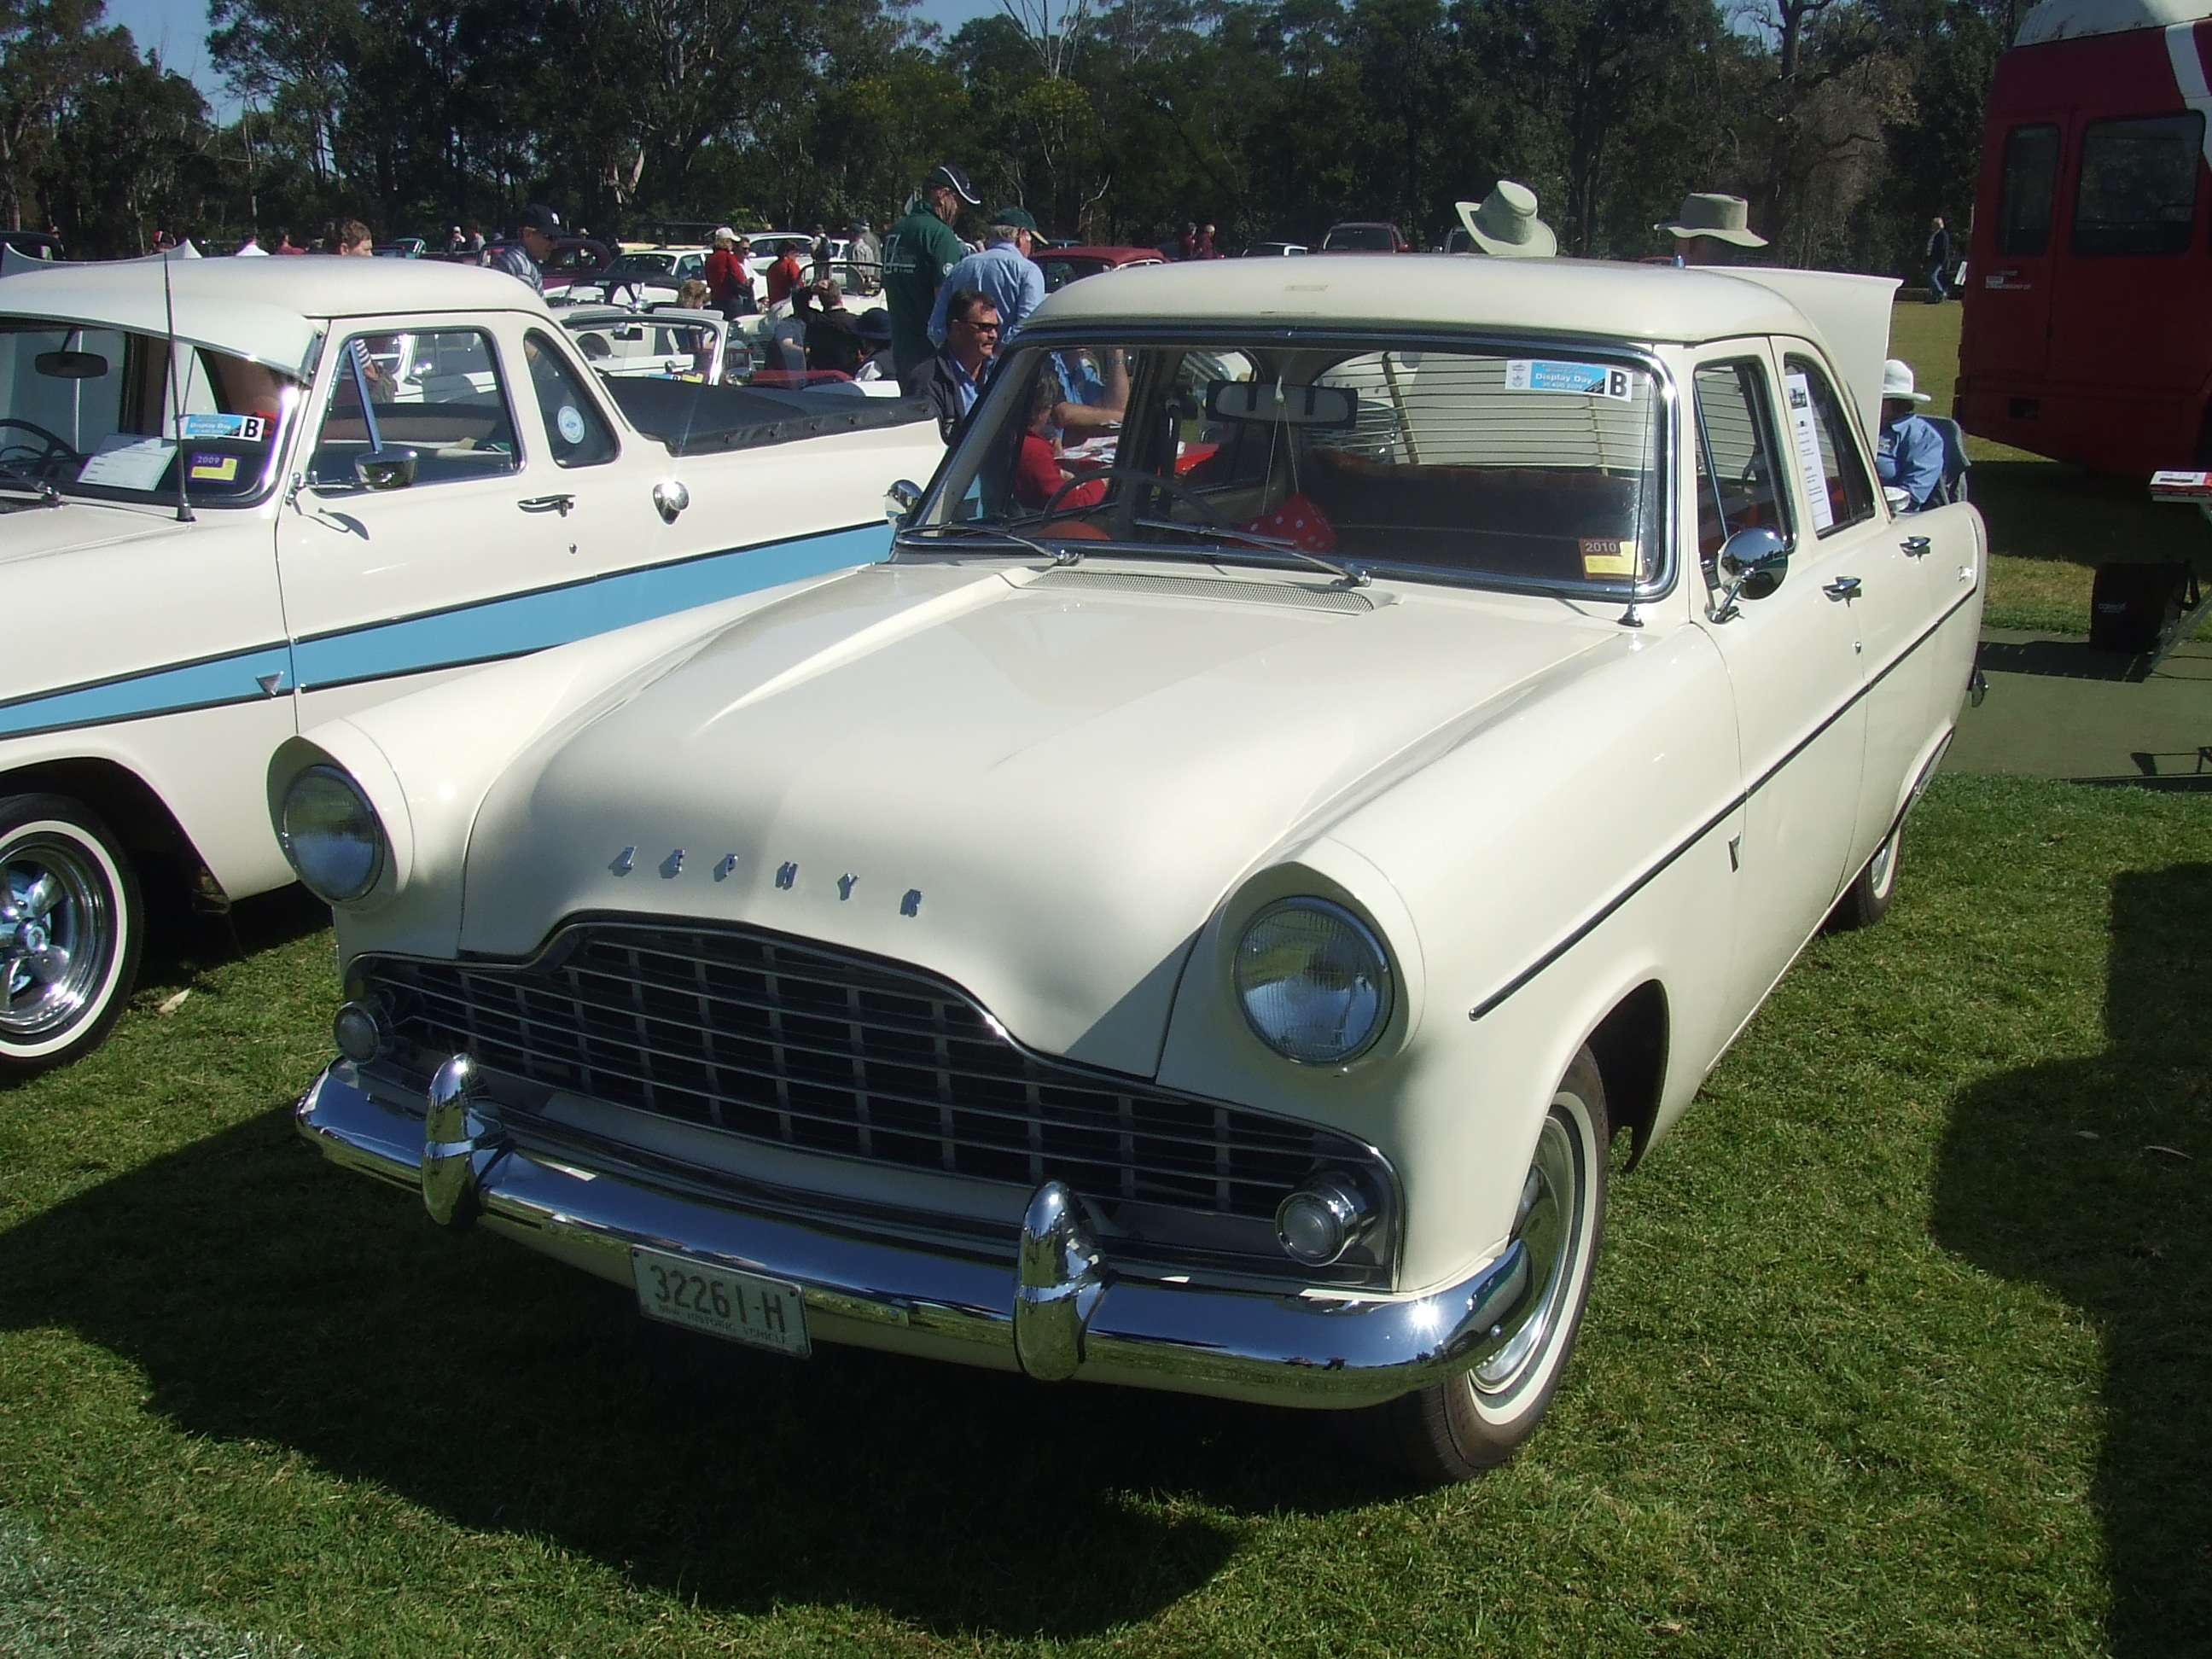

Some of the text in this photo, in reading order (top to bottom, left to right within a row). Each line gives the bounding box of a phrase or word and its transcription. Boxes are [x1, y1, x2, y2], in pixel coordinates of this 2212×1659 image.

[1535, 373, 1592, 385] Display Day
[1610, 371, 1627, 397] B
[244, 418, 259, 438] B
[1585, 542, 1617, 553] 2010
